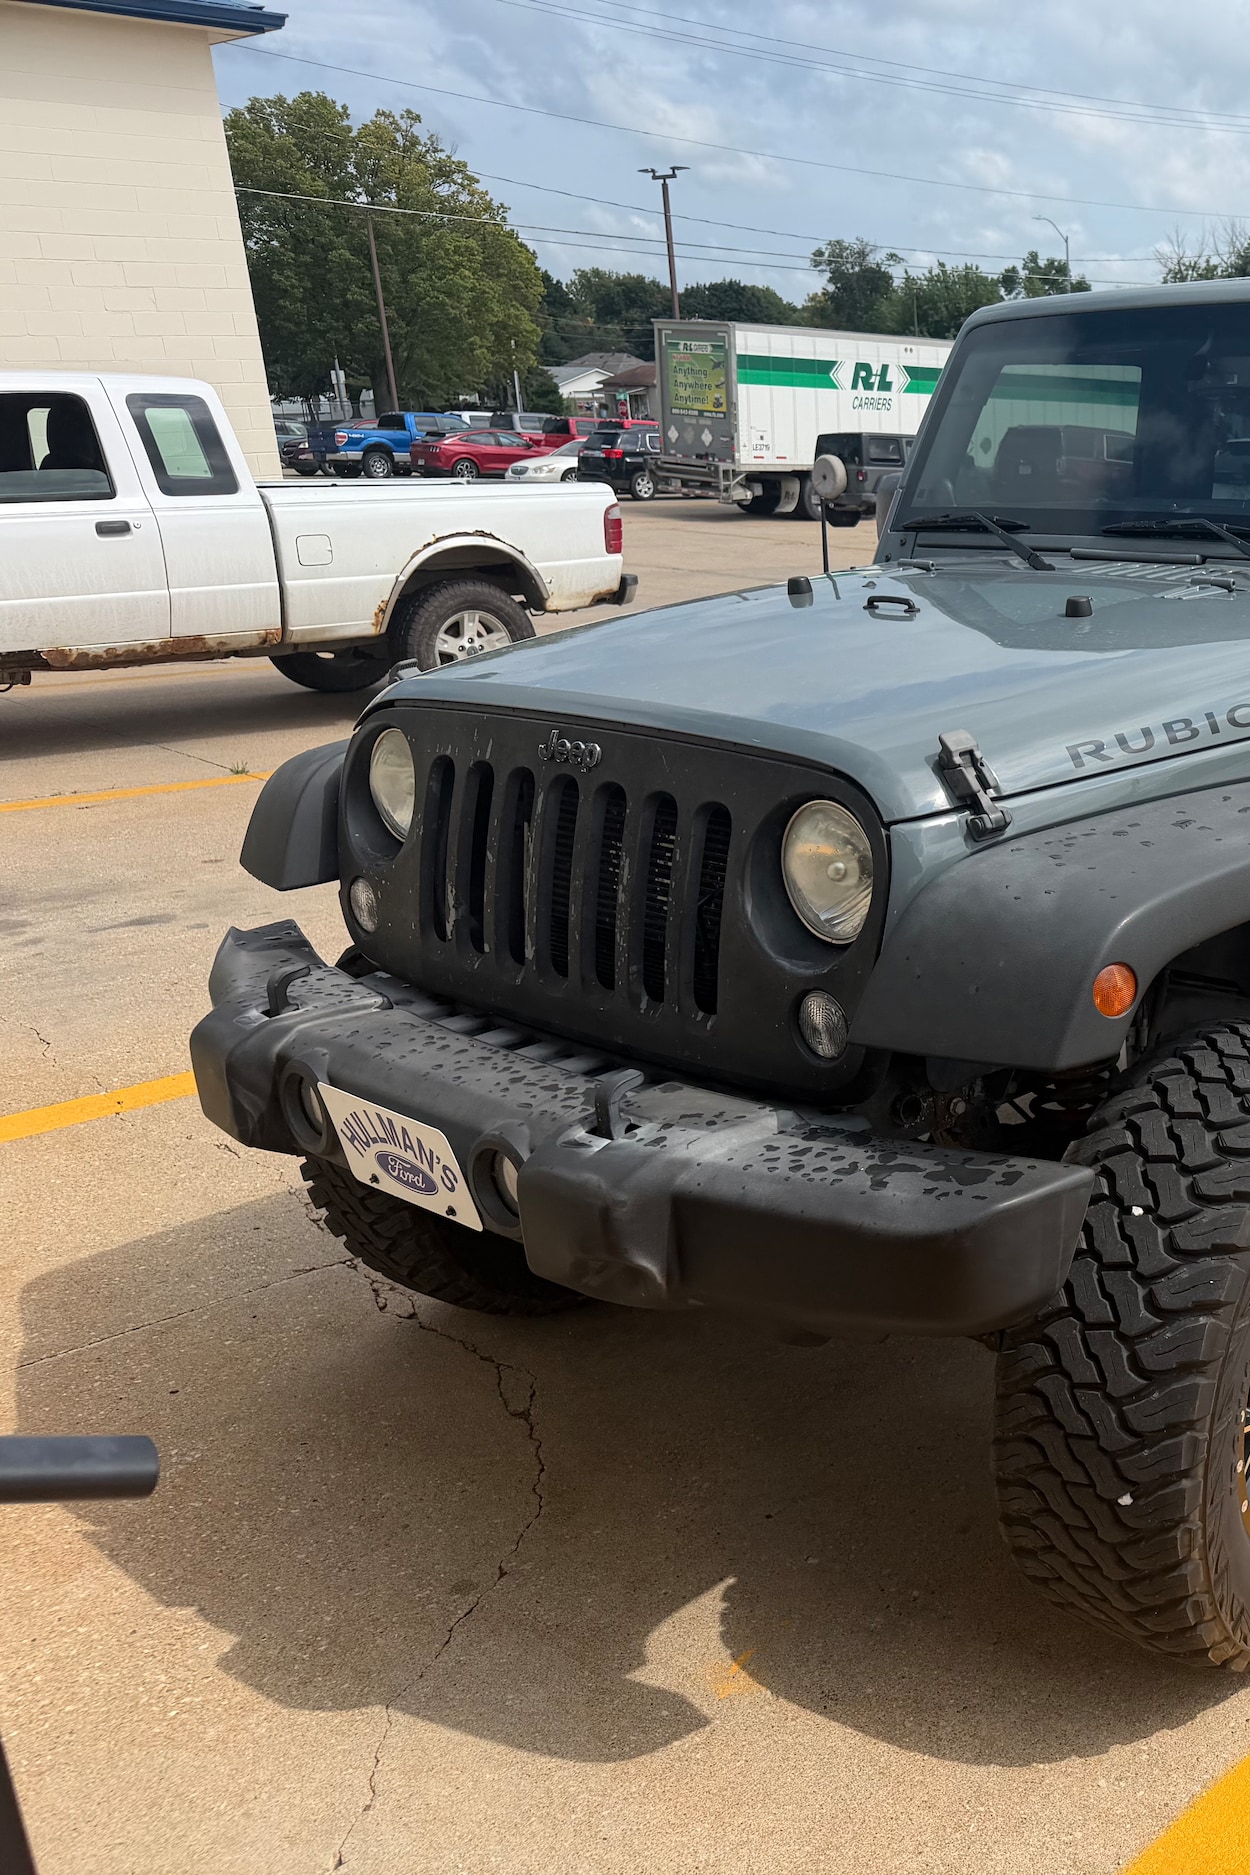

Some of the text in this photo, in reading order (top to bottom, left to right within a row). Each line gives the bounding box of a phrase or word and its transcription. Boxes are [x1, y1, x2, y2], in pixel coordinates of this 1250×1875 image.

[673, 365, 707, 378] Anything
[673, 379, 713, 391] Anywhere
[851, 362, 893, 392] R+L
[852, 396, 893, 411] CARRIERS
[538, 729, 602, 773] Jeep
[340, 1109, 459, 1193] HULLMAN'S
[387, 1155, 426, 1189] Ford
